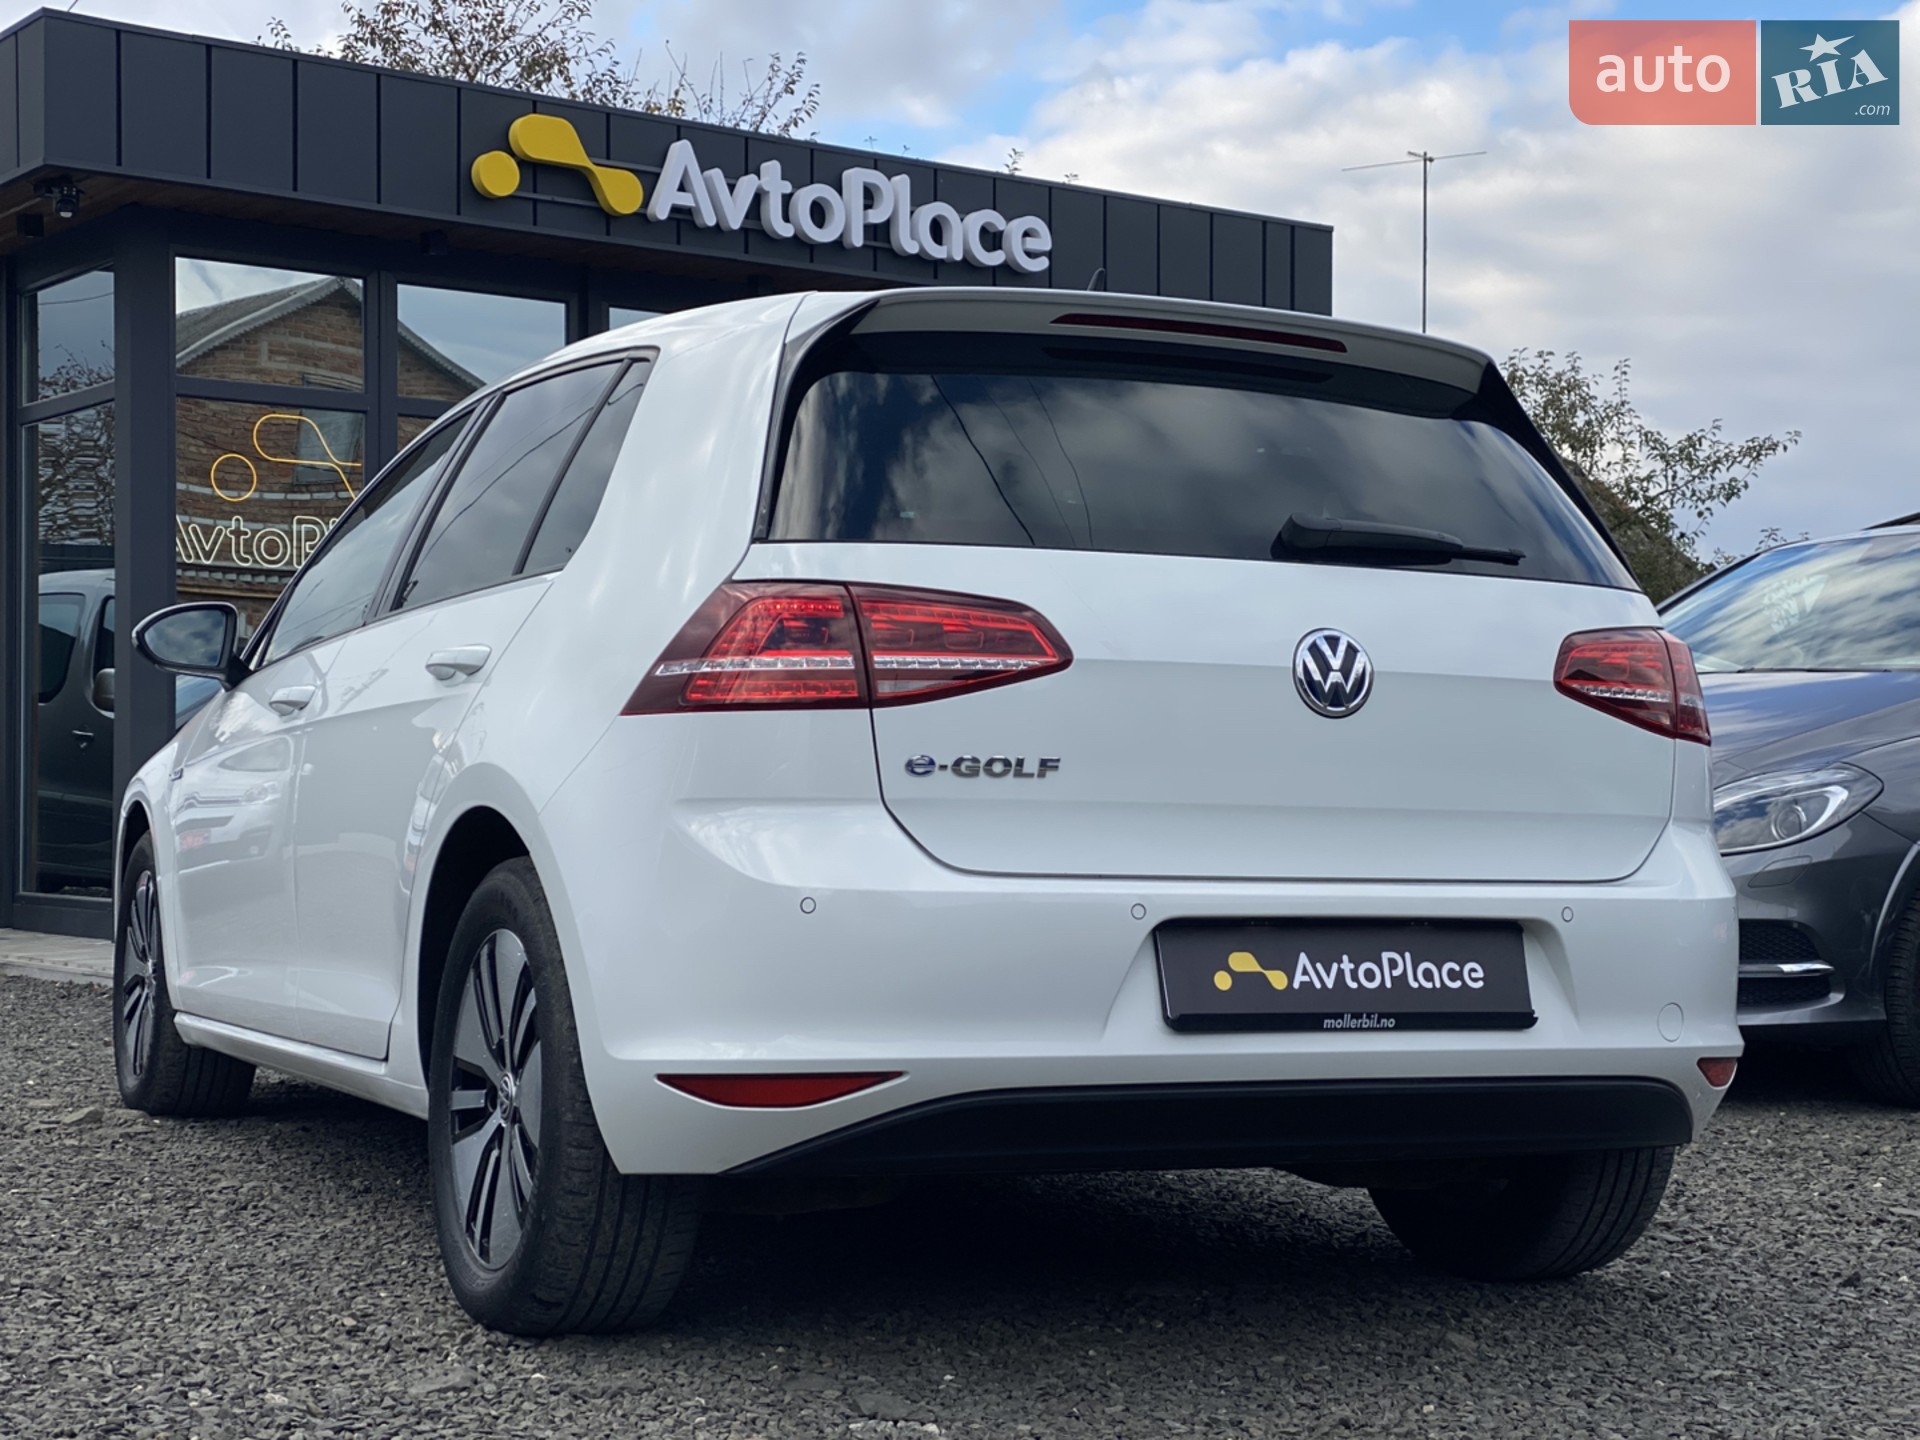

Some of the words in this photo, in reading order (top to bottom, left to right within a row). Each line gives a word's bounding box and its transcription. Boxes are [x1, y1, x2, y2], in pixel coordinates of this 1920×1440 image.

[646, 138, 1053, 273] AvtoPlace
[176, 514, 339, 568] vtoP
[905, 754, 1062, 779] e-GOLF
[1293, 951, 1485, 990] AvtoPlace
[1323, 1013, 1397, 1029] mollerbil.no
